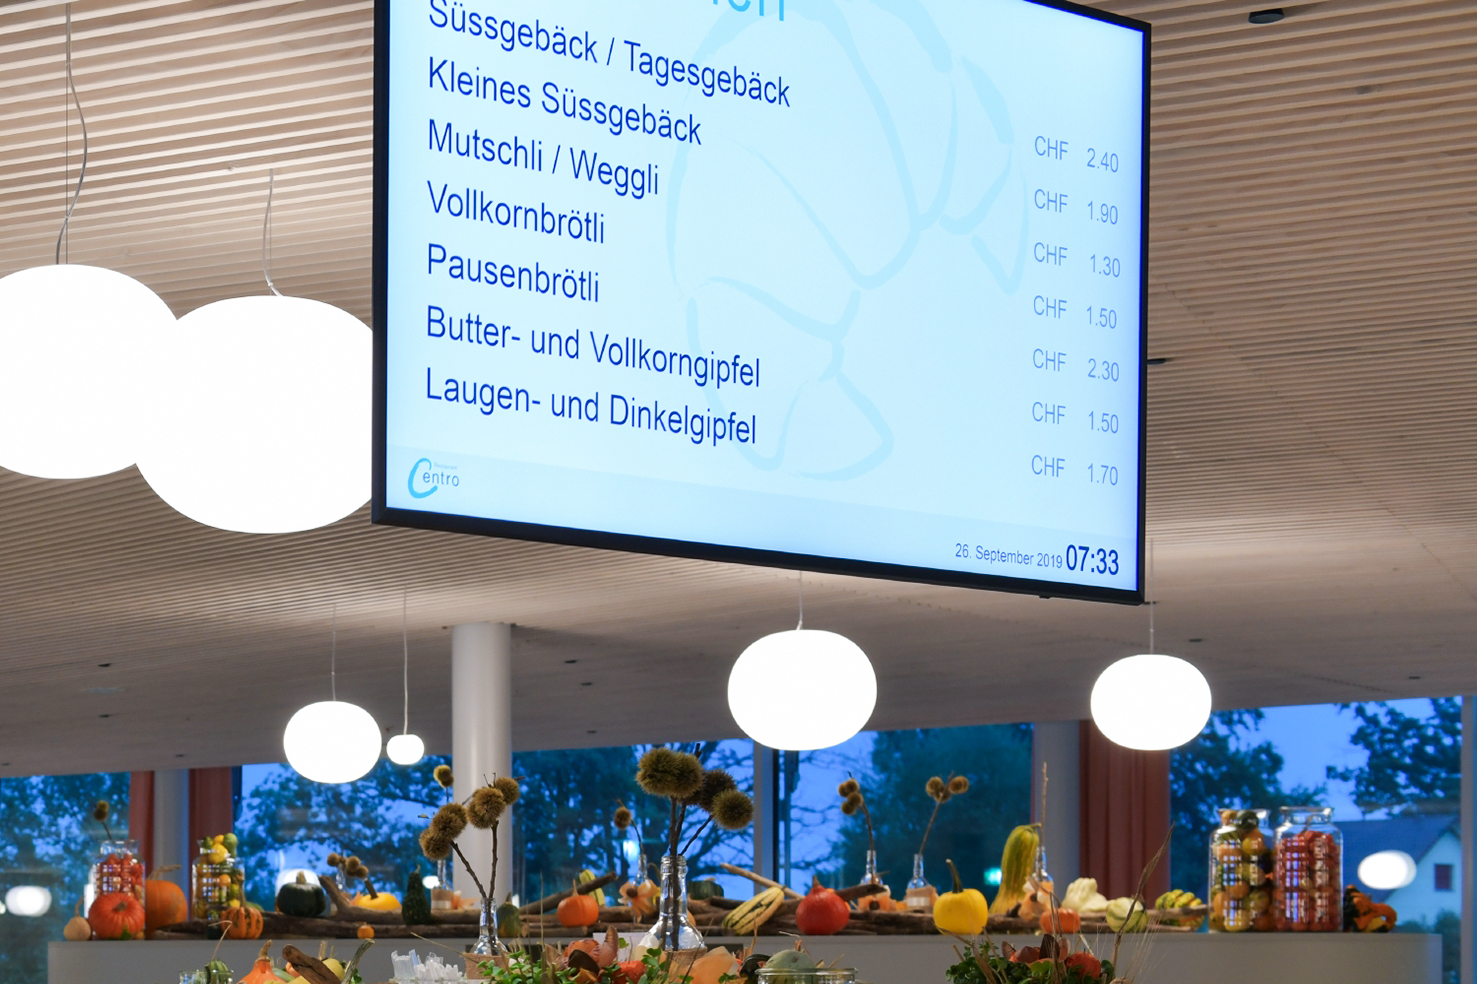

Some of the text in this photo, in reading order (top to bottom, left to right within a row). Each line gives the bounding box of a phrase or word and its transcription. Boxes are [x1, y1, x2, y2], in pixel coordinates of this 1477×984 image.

[429, 0, 790, 107] Süssgebäck / Tagesgebäck
[429, 56, 701, 145] Kleines Süssgebäck
[429, 118, 658, 200] Mutschli / Weggli
[1035, 136, 1118, 173] CHF 2.40
[427, 180, 604, 244] Vollkornbrötli
[1035, 189, 1118, 225] CHF 1.90
[428, 243, 598, 302] Pausenbrötli
[1034, 242, 1120, 277] CHF 1.30
[1034, 295, 1117, 329] CHF 1.50
[427, 305, 759, 389] Butter- und Vollkorngipfel
[1033, 349, 1119, 382] CHF 2.30
[427, 367, 756, 447] Laugen- und Dinkelgipfel
[1032, 402, 1118, 433] CHF 1.50
[1032, 455, 1118, 485] CHF 1.70
[955, 543, 1119, 575] 26. September 2019 07:33
